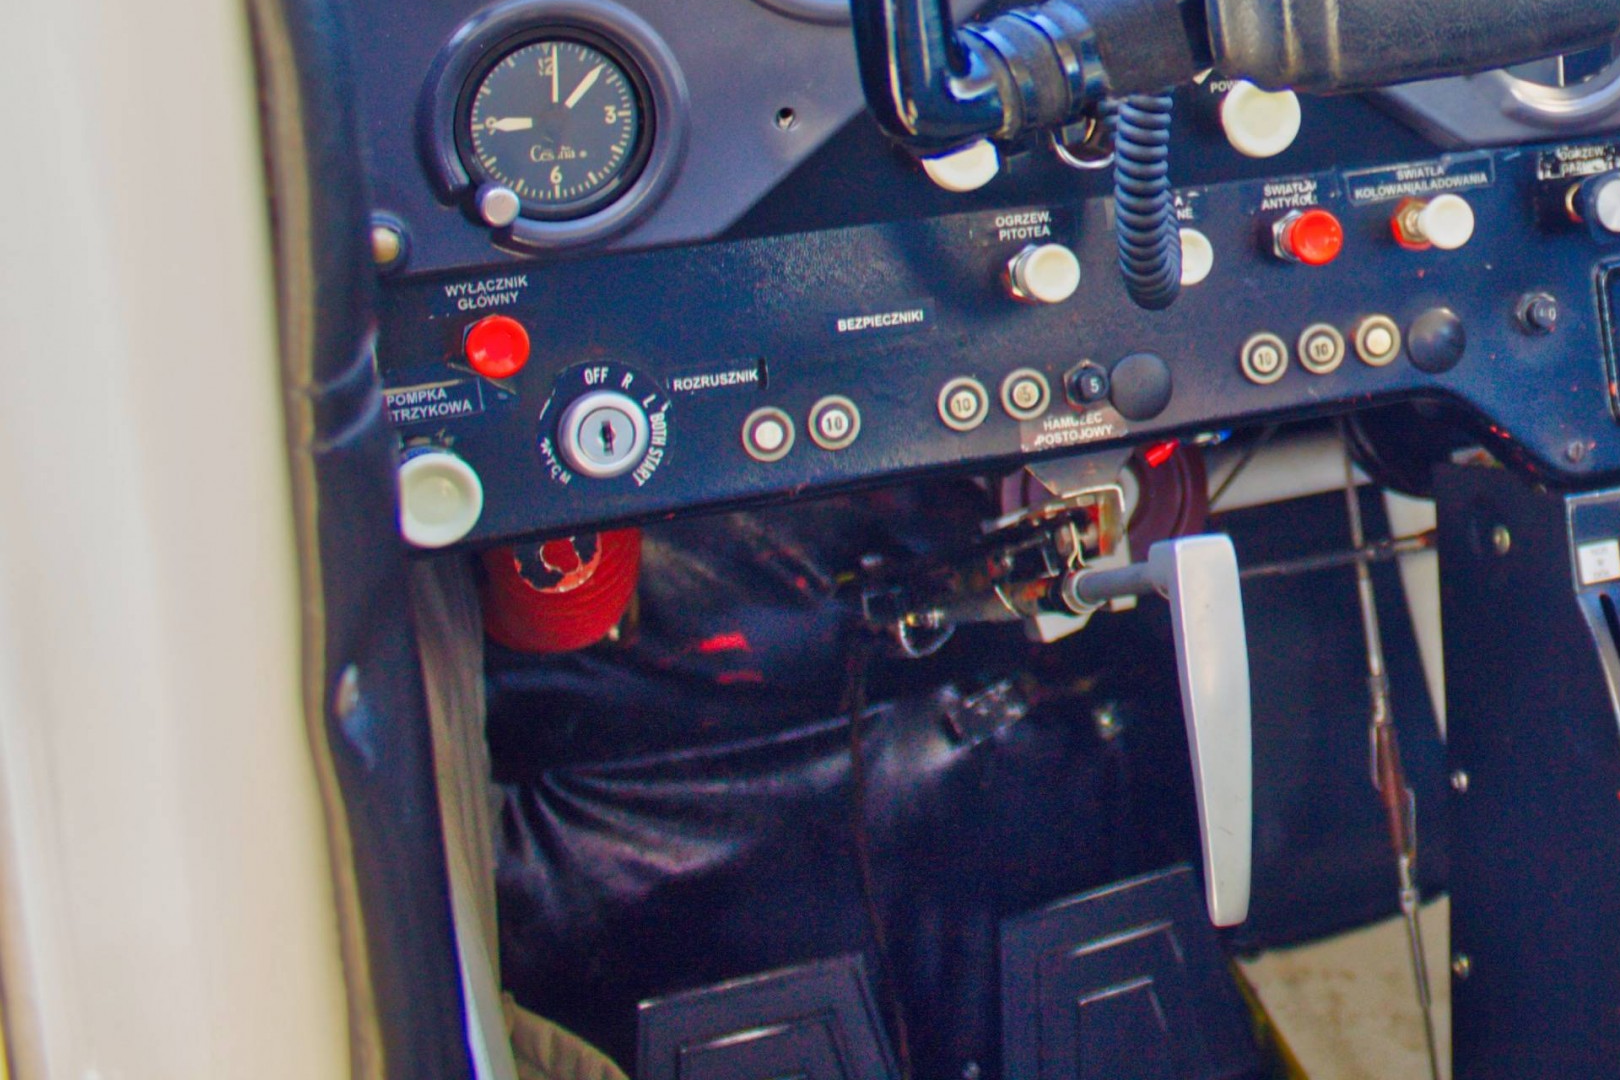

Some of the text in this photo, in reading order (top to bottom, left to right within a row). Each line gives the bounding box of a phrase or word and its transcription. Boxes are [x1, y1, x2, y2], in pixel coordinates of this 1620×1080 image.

[604, 106, 616, 124] 3
[530, 145, 576, 162] Cesna
[550, 166, 562, 183] 6
[445, 274, 528, 297] WYŁĄCZNIK
[458, 291, 518, 310] GŁÓWNY
[837, 309, 924, 332] BEZPIECZNIKI
[584, 366, 609, 386] OFF
[621, 372, 633, 389] R
[673, 369, 758, 391] ROZRUSZNIK
[1090, 378, 1099, 393] 5
[387, 388, 447, 407] POMPKA
[643, 394, 656, 408] L
[956, 398, 971, 412] 10
[650, 412, 667, 446] BOTH
[827, 417, 843, 431] 10
[632, 447, 663, 487] START
